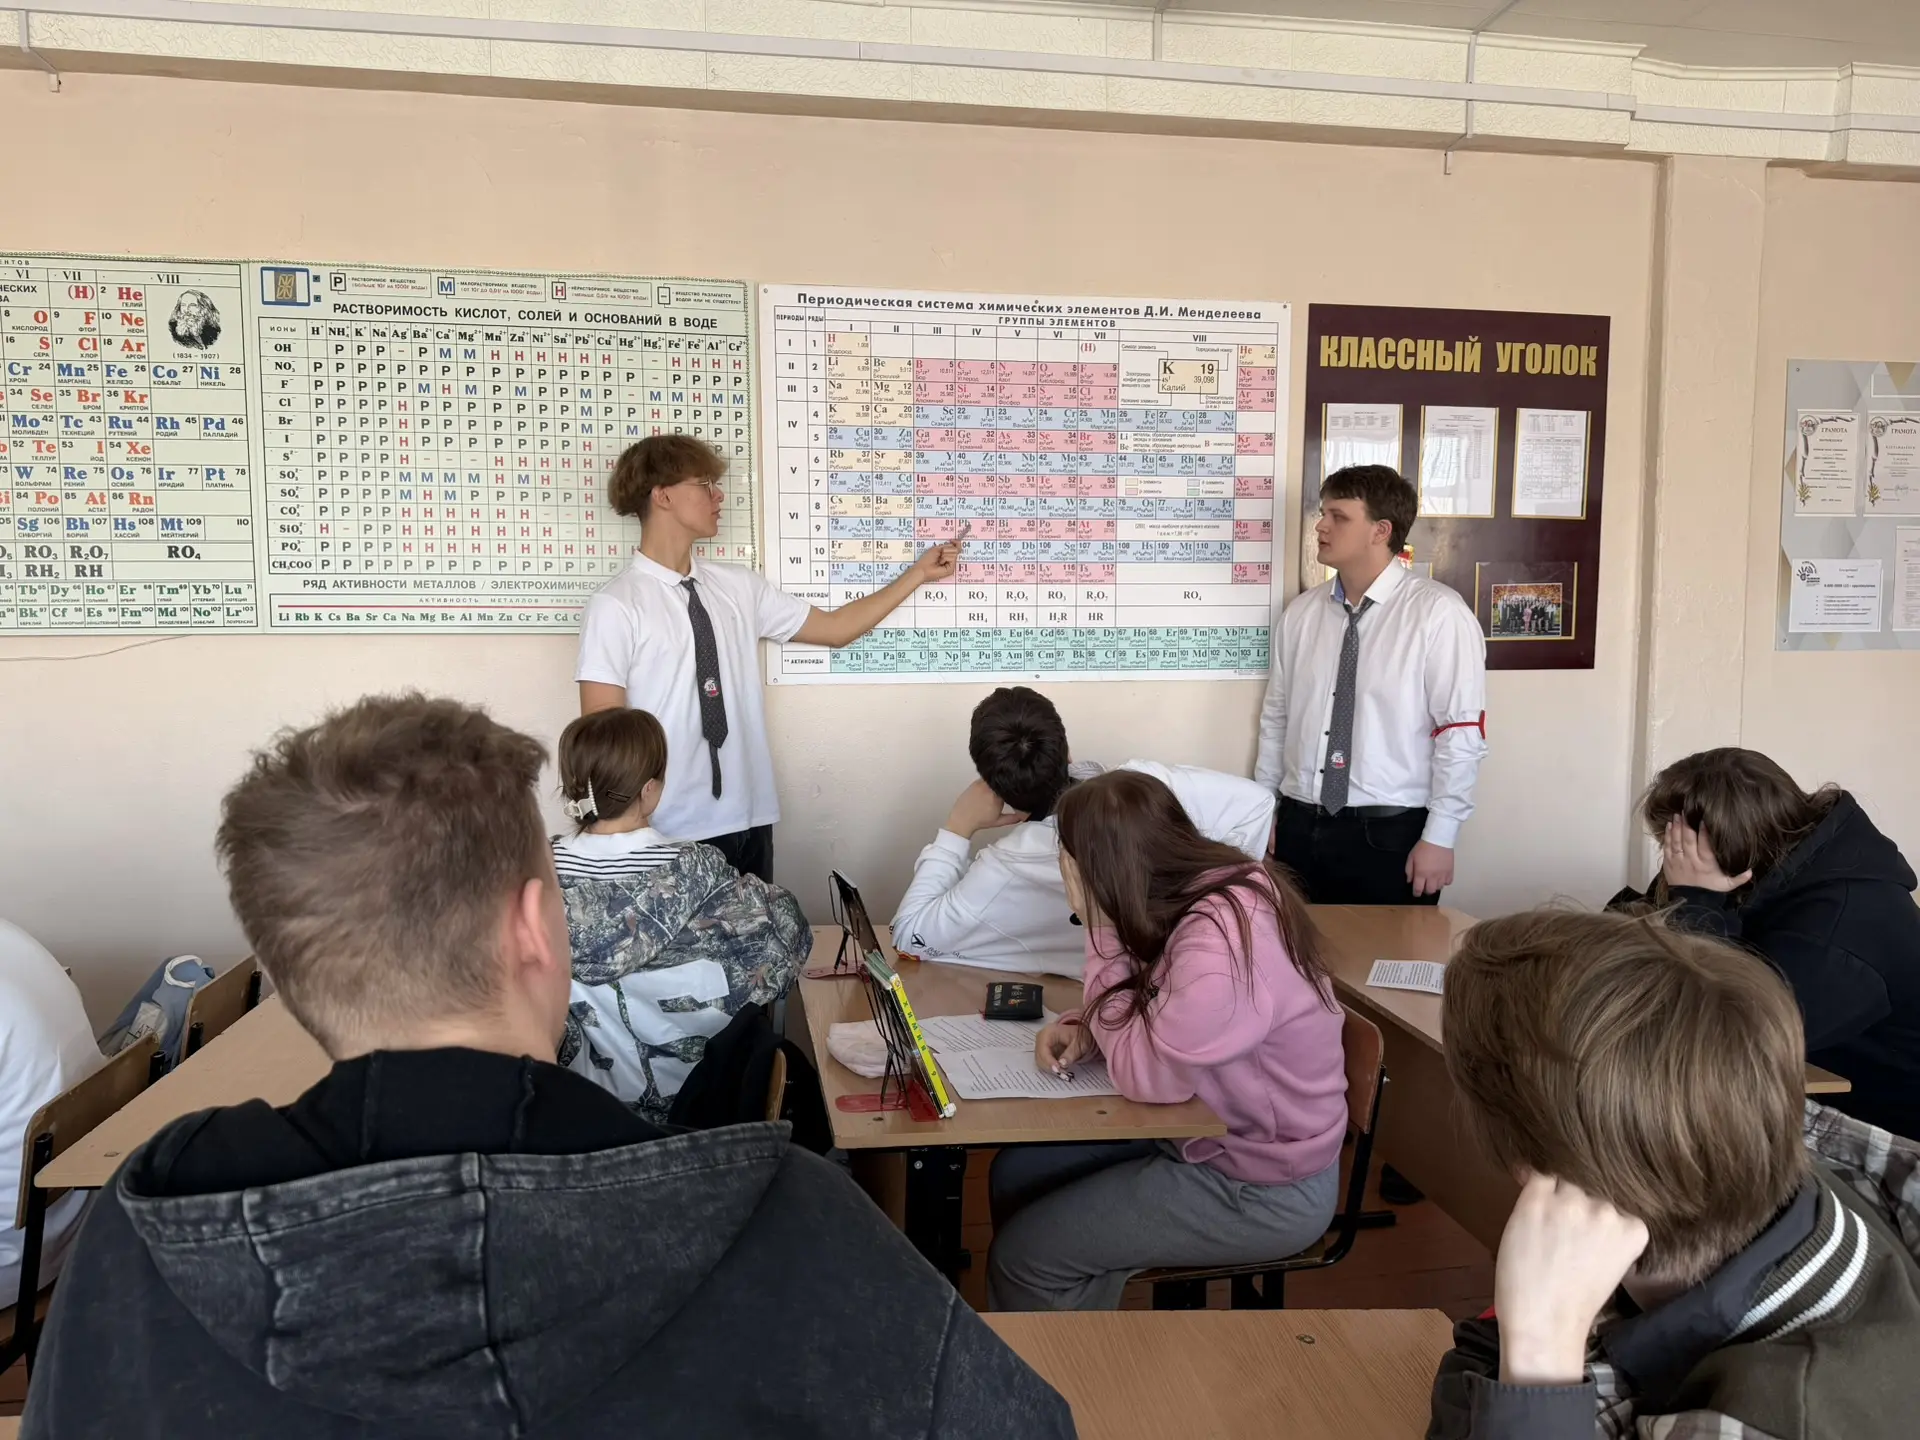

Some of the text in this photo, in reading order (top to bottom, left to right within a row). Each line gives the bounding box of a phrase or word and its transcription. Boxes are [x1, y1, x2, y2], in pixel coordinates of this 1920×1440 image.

[16, 270, 29, 279] VI
[63, 271, 81, 280] VII
[157, 274, 180, 284] VIII
[68, 284, 95, 300] (H)
[118, 287, 143, 300] He
[797, 293, 1261, 319] Периодическая система химических элементов Д.И. Менделеева
[34, 310, 48, 323] O
[84, 312, 96, 324] F
[121, 313, 145, 326] Ne
[333, 303, 718, 329] РАСТВОРИМОСТЬ КИСЛОТ, СОЛЕЙ И ОСНОВАНИЙ В ВОДЕ
[999, 316, 1116, 327] ГРУППЫ ЭЛЕМЕНТОВ
[39, 337, 50, 350] S
[78, 338, 98, 351] Cl
[828, 334, 836, 343] H
[121, 339, 145, 352] Ar
[1240, 346, 1252, 355] He
[1320, 335, 1598, 376] КЛАССНЫЙ УГОЛОК
[8, 362, 32, 376] Cr
[916, 360, 923, 368] B
[1163, 362, 1214, 374] K 19
[57, 364, 85, 377] Mn
[106, 365, 128, 377] Fe
[153, 366, 178, 378] Co
[201, 367, 220, 379] Ni
[1239, 368, 1251, 376] Ne
[828, 381, 842, 390] Na
[1194, 376, 1214, 384] 39,098
[916, 383, 927, 391] Al
[15, 466, 33, 479] W
[205, 468, 226, 481] Pt
[160, 518, 202, 531] Mt 109
[304, 580, 327, 590] РЯД
[333, 580, 407, 588] АКТИВНОСТИ
[413, 580, 476, 590] МЕТАЛЛОВ
[279, 613, 568, 622] Li Rb K Cs Ba Sr Ca Na Mg Be Al Mn Zn Cr Fe Cd
[1088, 612, 1103, 621] HR
